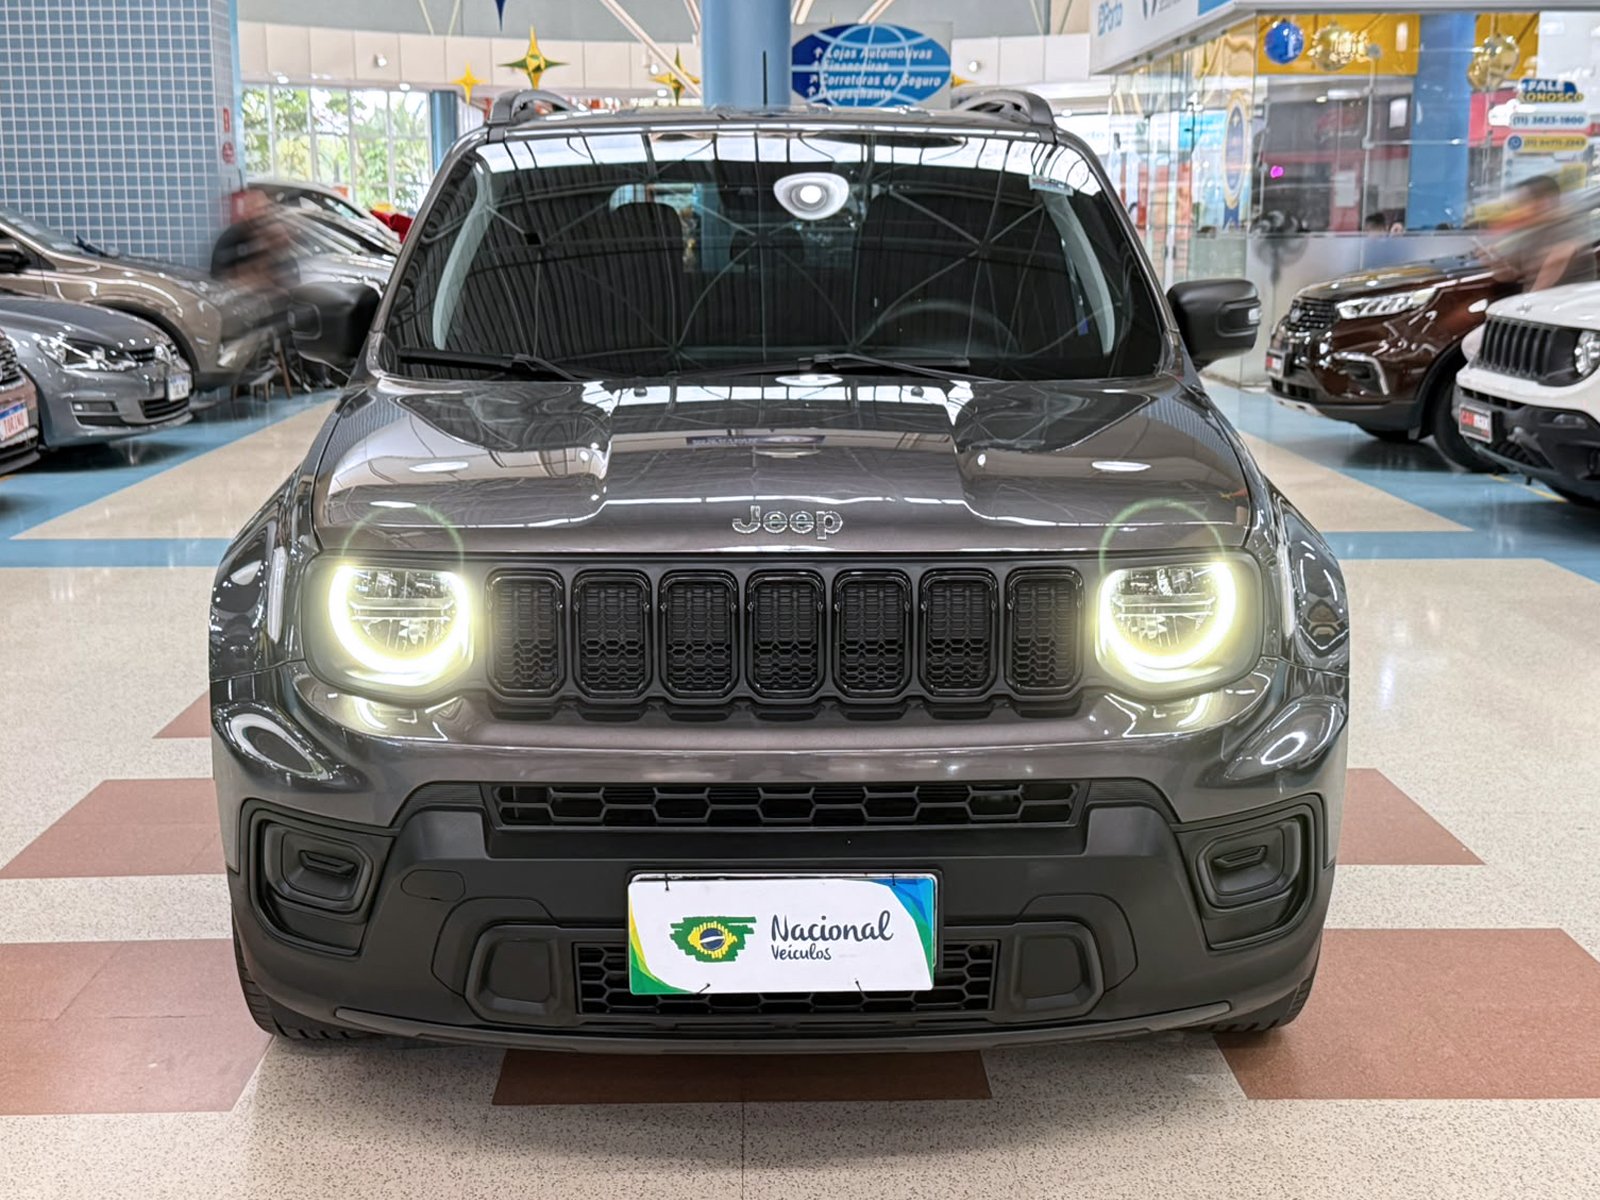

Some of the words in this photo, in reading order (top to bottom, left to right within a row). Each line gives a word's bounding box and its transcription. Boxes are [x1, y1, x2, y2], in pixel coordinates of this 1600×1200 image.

[826, 47, 857, 61] Lojas
[860, 47, 933, 60] Automotivas
[821, 74, 880, 86] Corretoras
[883, 74, 898, 86] de
[901, 74, 941, 88] Seguro
[1527, 80, 1564, 92] FALE
[732, 505, 843, 540] Jeep
[771, 910, 894, 942] Nacional
[771, 943, 832, 961] Veículos
